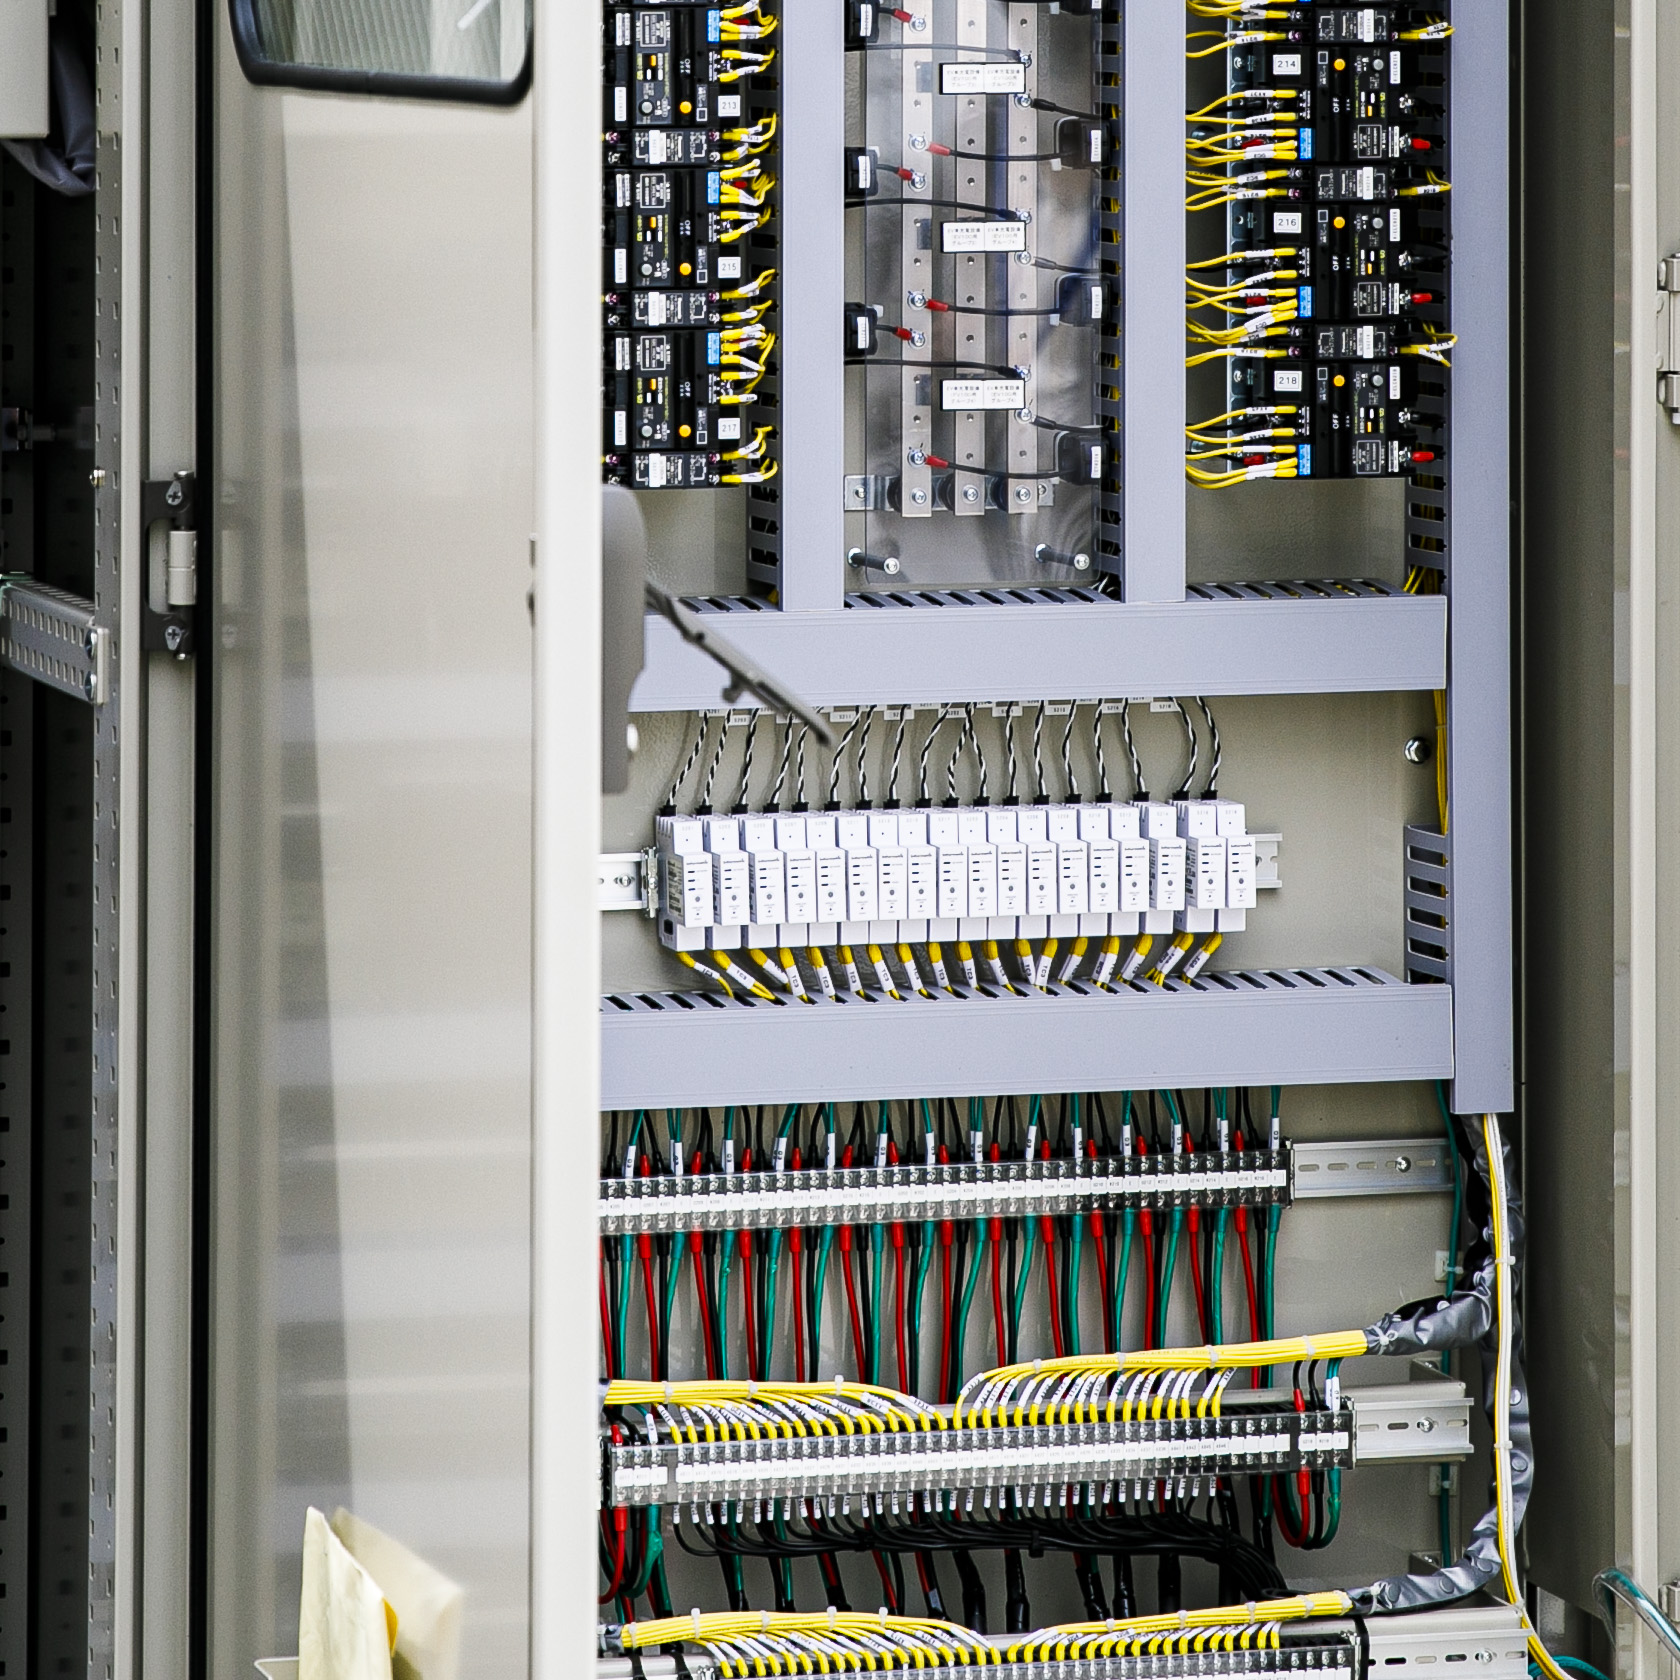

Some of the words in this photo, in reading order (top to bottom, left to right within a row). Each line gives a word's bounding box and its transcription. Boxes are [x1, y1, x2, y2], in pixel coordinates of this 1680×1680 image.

[1276, 59, 1296, 69] 214
[722, 100, 737, 110] 213
[1277, 217, 1297, 227] 216
[722, 262, 737, 272] 215
[1277, 376, 1297, 386] 218
[722, 423, 737, 433] 217
[881, 969, 890, 982] TC3
[1039, 964, 1048, 978] TC3
[791, 974, 800, 988] TC3
[849, 970, 857, 983] TC3
[822, 975, 830, 989] TC3
